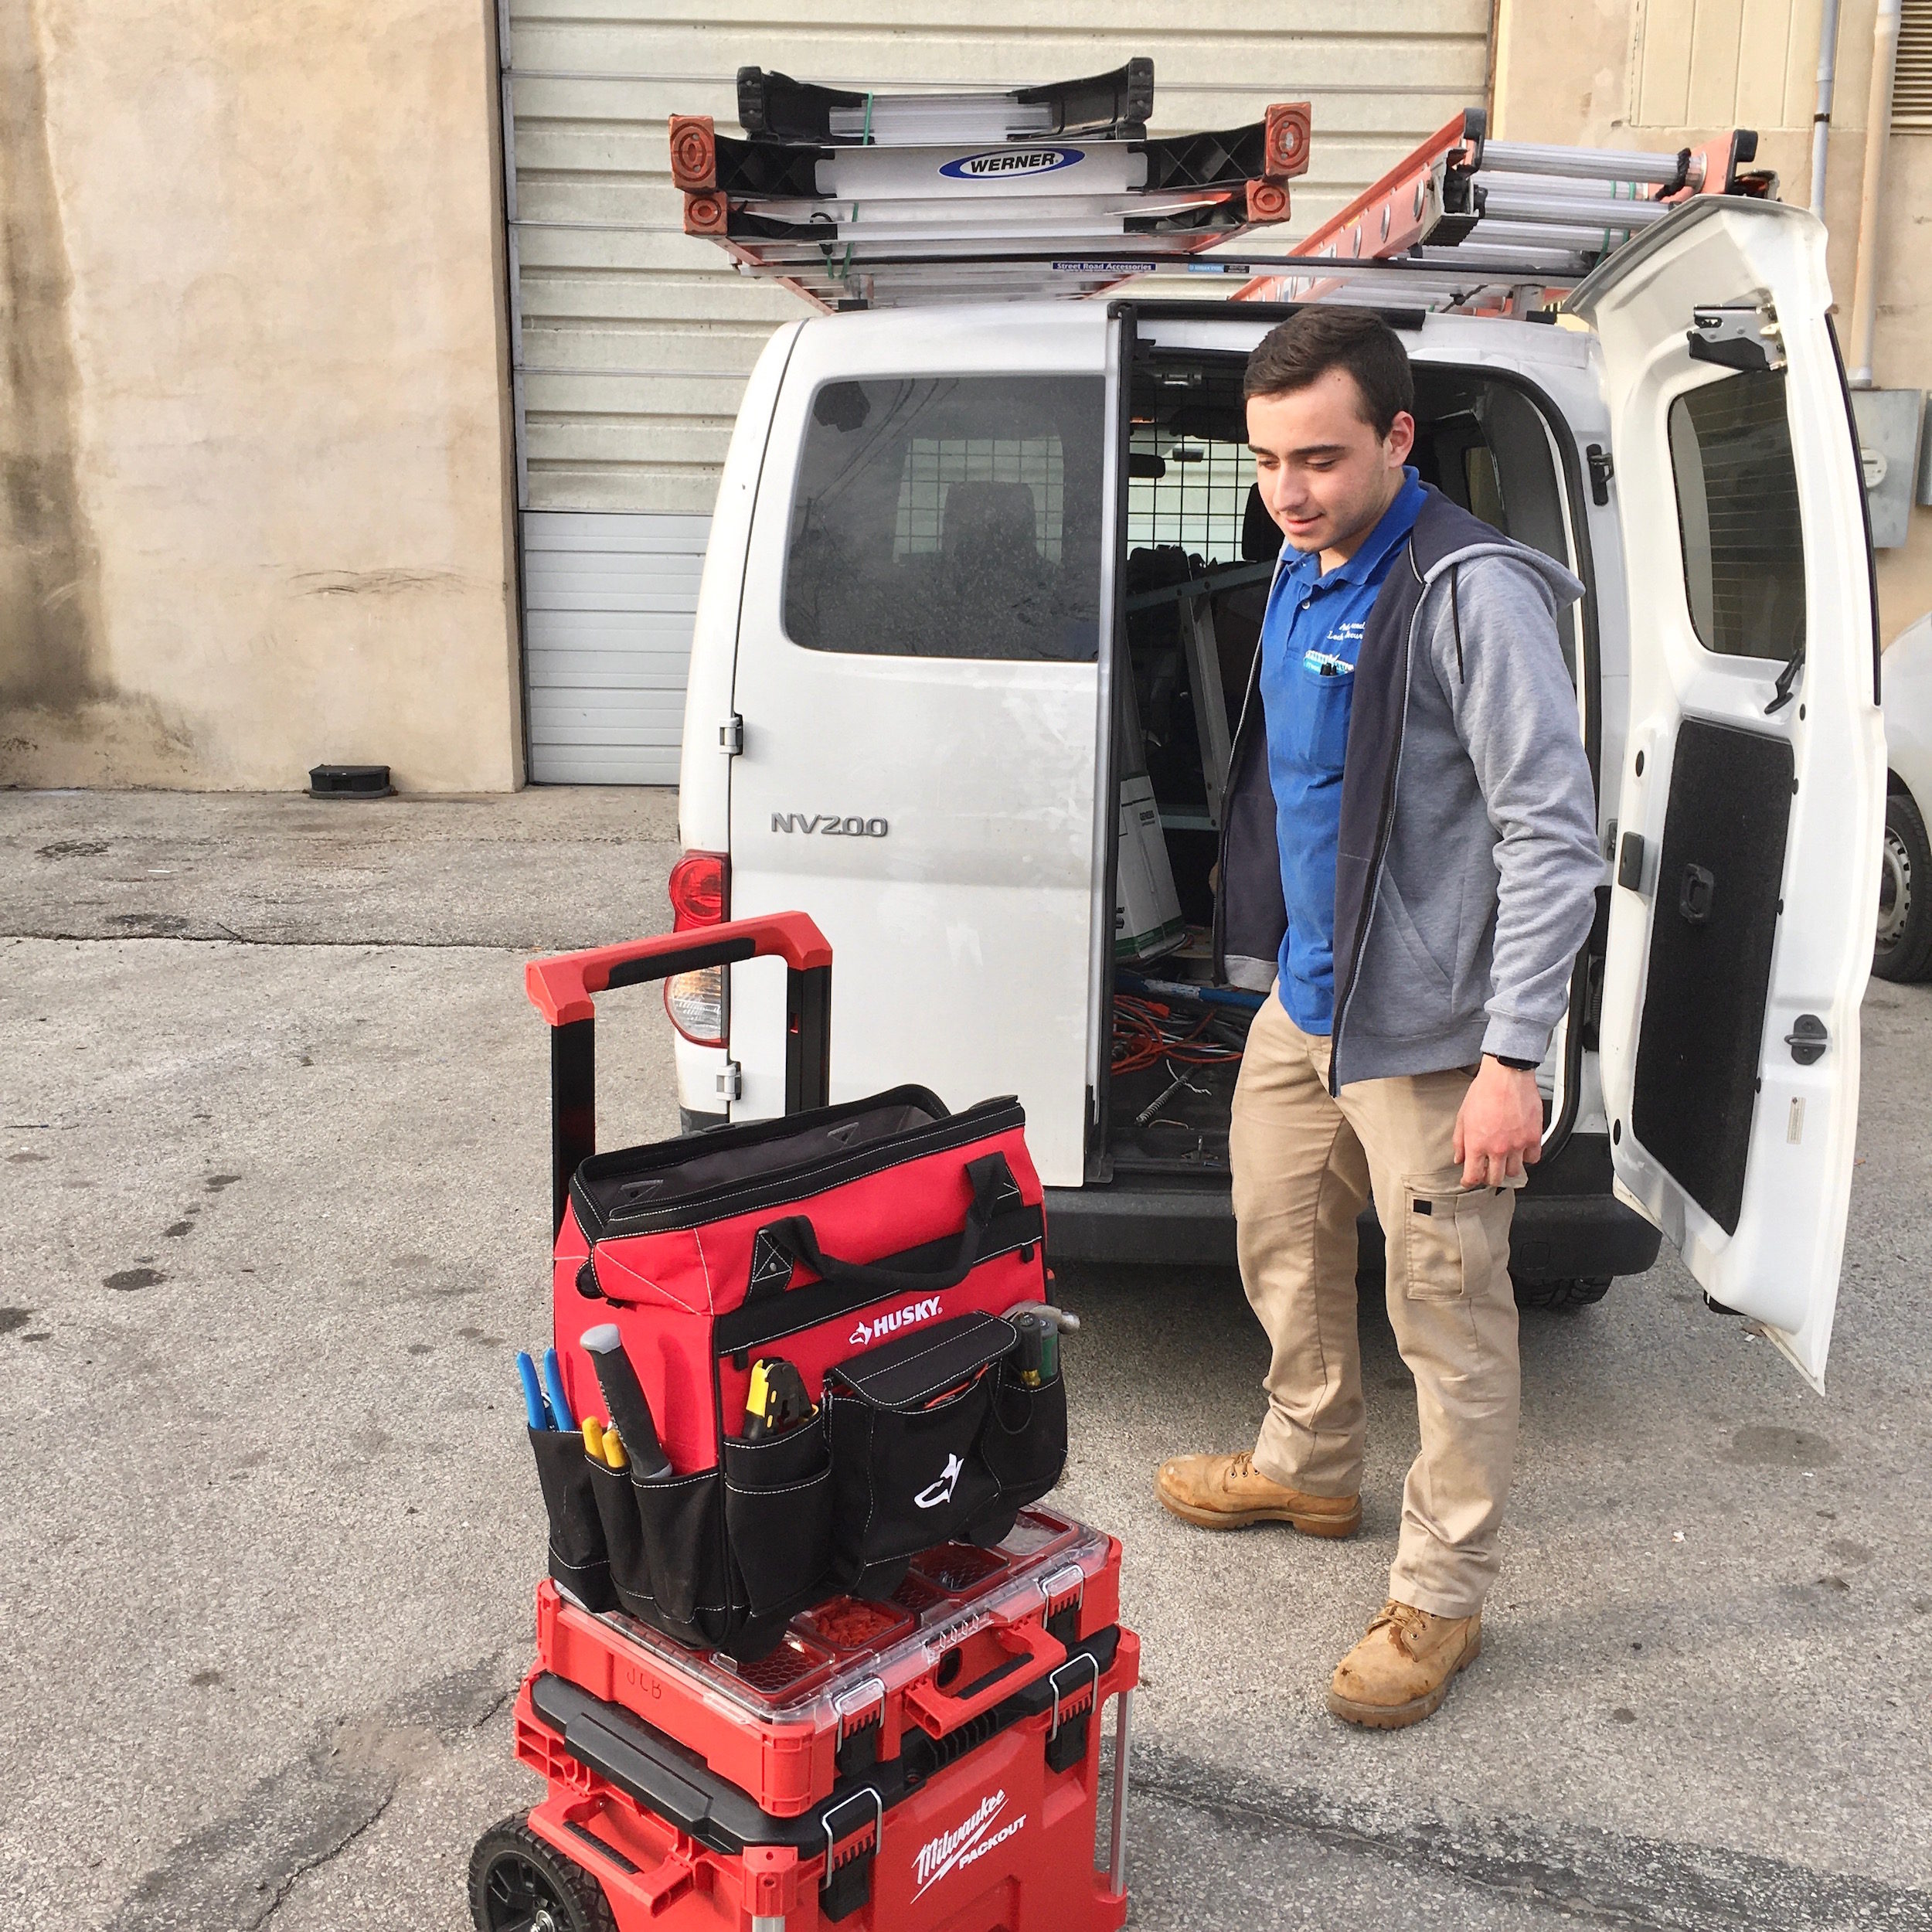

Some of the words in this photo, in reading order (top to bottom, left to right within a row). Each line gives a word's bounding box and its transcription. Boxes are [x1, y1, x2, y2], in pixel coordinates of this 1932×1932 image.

[971, 153, 1056, 173] WERNER
[771, 812, 888, 837] NV200
[873, 1295, 940, 1338] HUSKY
[911, 1789, 1005, 1885] Milwaukee
[958, 1814, 1027, 1870] PACKOUT
